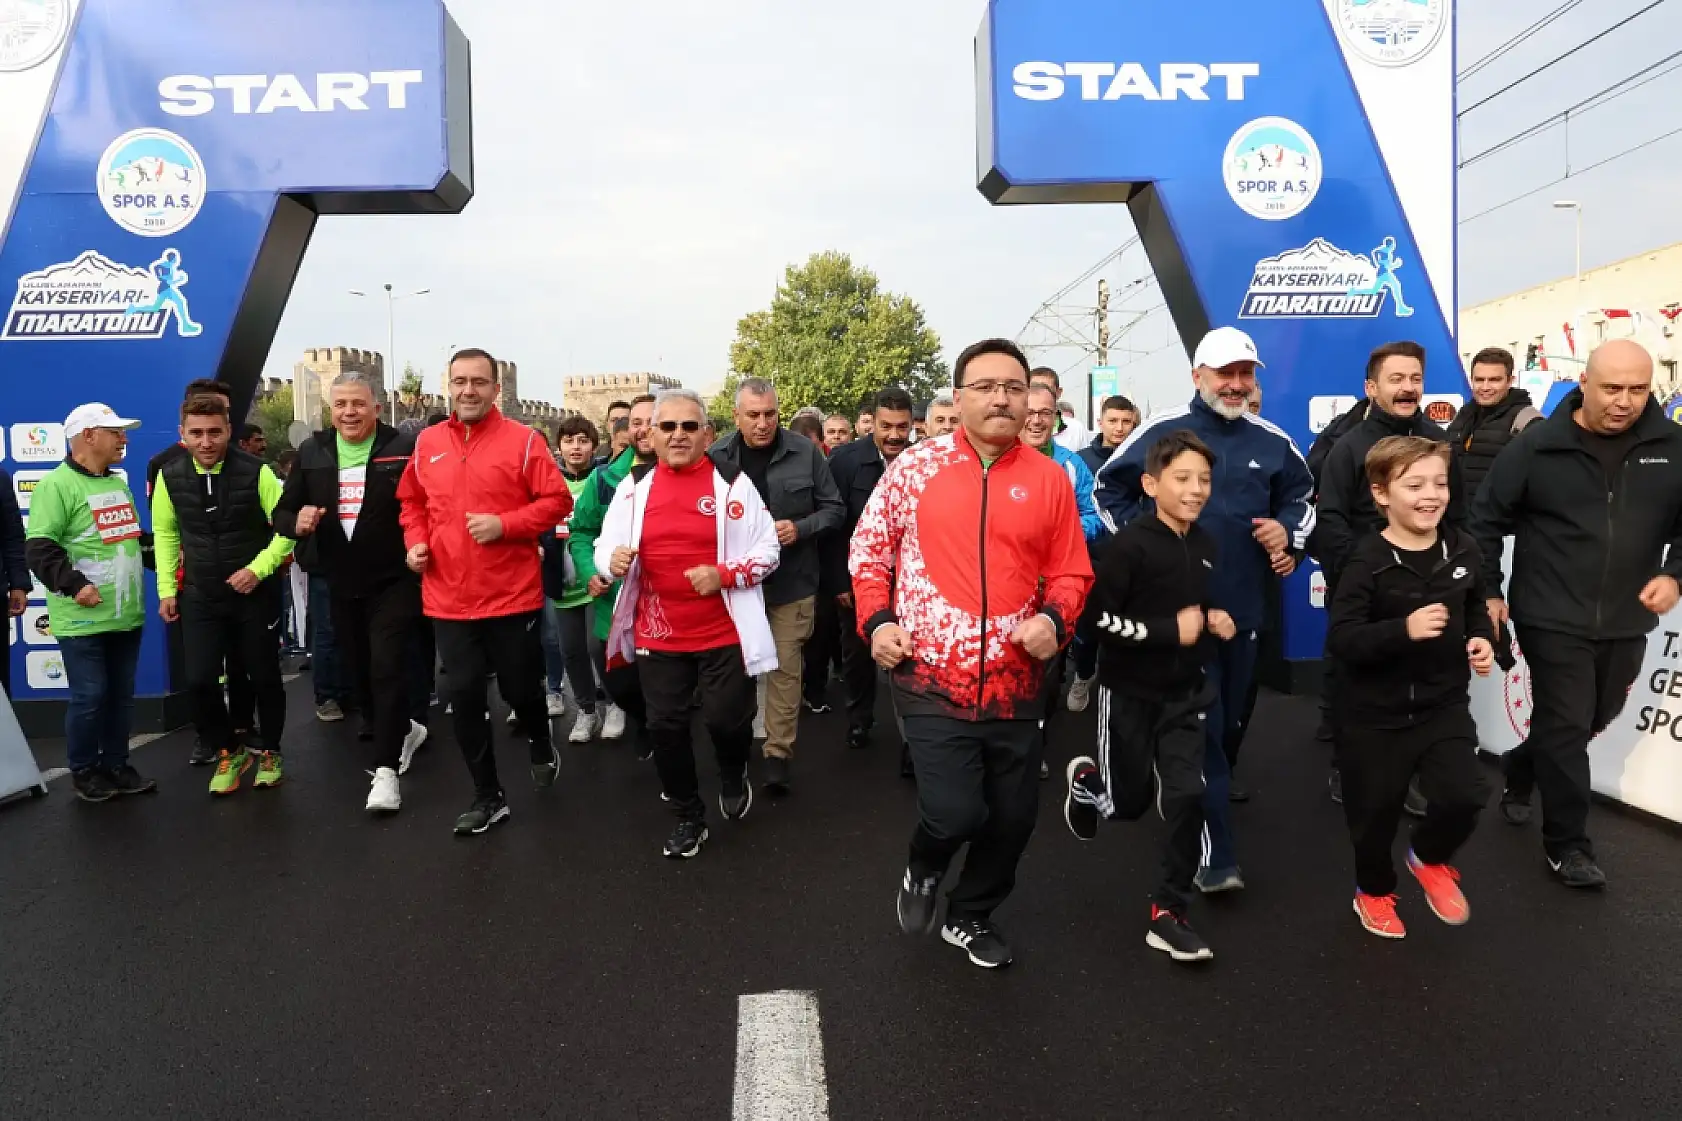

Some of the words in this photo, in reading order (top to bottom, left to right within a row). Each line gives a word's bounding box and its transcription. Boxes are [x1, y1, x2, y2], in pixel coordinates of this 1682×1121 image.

[158, 70, 423, 117] START
[1012, 61, 1260, 101] START
[1236, 179, 1278, 193] SPOR
[112, 193, 157, 209] SPOR
